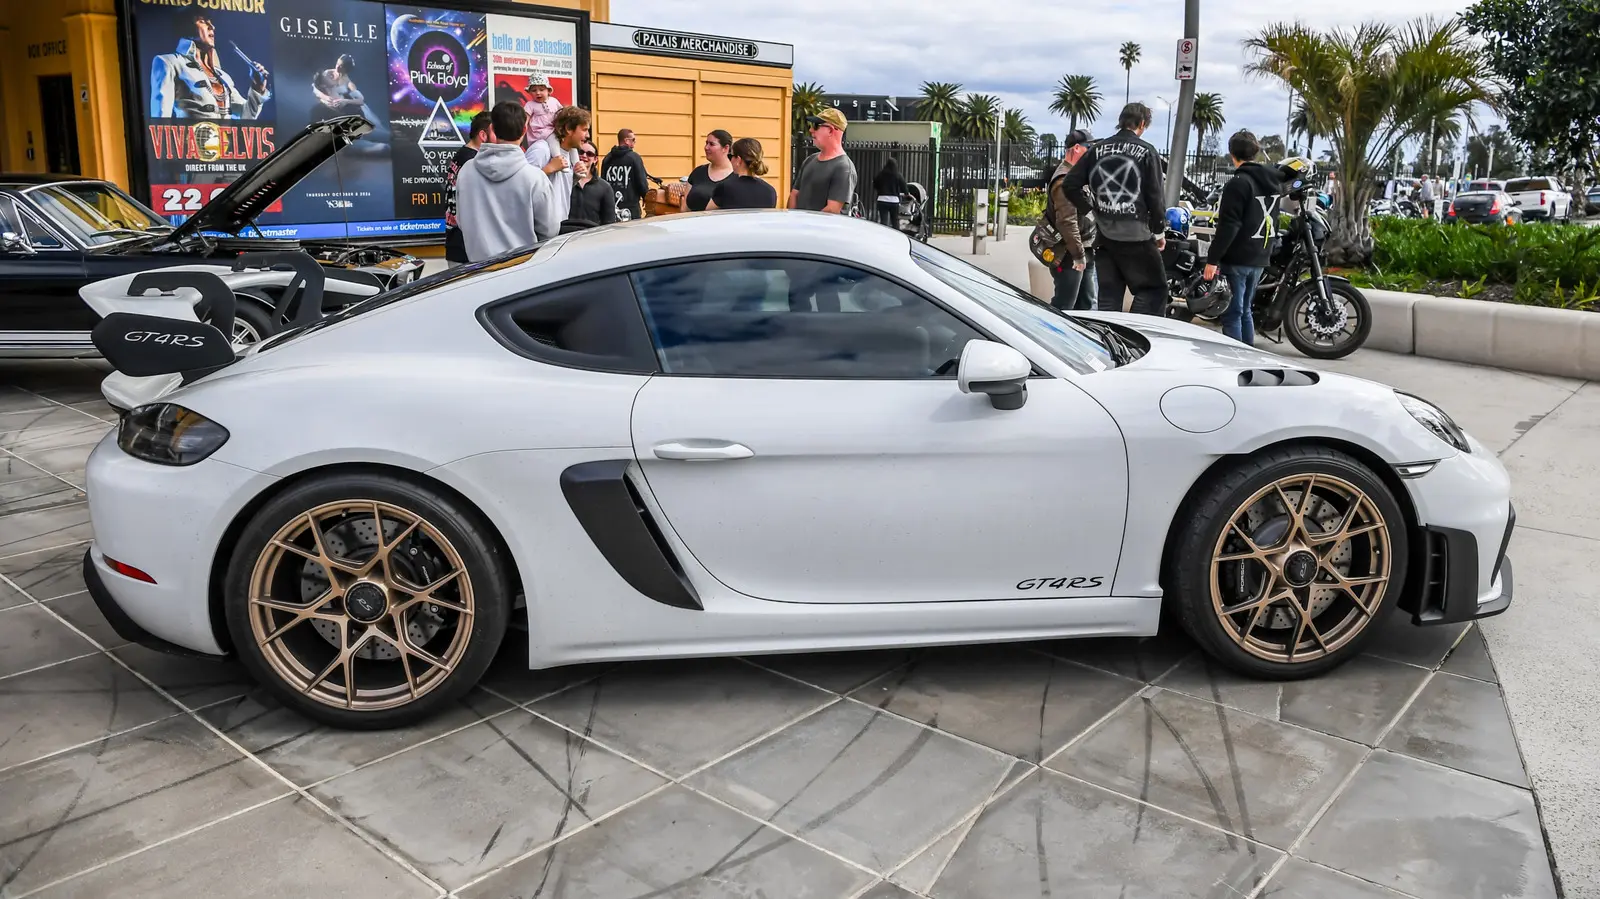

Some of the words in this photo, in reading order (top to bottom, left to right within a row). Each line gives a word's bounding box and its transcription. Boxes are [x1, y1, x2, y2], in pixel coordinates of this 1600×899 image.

[280, 16, 378, 40] GISELLE
[42, 39, 67, 57] OFFICE
[492, 33, 513, 51] belle
[516, 36, 531, 52] and
[533, 38, 573, 56] sebastian
[643, 33, 678, 48] PALAIS
[680, 38, 749, 56] MERCHANDISE
[426, 61, 445, 70] Echoes
[445, 62, 454, 73] of
[503, 56, 529, 67] anniversary
[529, 58, 538, 66] tour
[410, 70, 435, 84] Pink
[437, 72, 468, 88] Floyd
[149, 125, 200, 159] VIVA
[219, 126, 275, 159] ELVIS
[424, 151, 436, 160] 60
[185, 163, 207, 172] DIRECT
[207, 163, 225, 172] FROM
[226, 164, 237, 172] THE
[238, 164, 247, 172] UK
[421, 165, 439, 173] PINK
[162, 188, 202, 211] 22
[411, 193, 428, 205] FRI
[432, 193, 441, 205] 11
[248, 228, 298, 238] ticetmaster
[400, 222, 441, 231] ticketmaster
[124, 331, 205, 347] GT4RS
[1016, 576, 1104, 590] GT4RS
